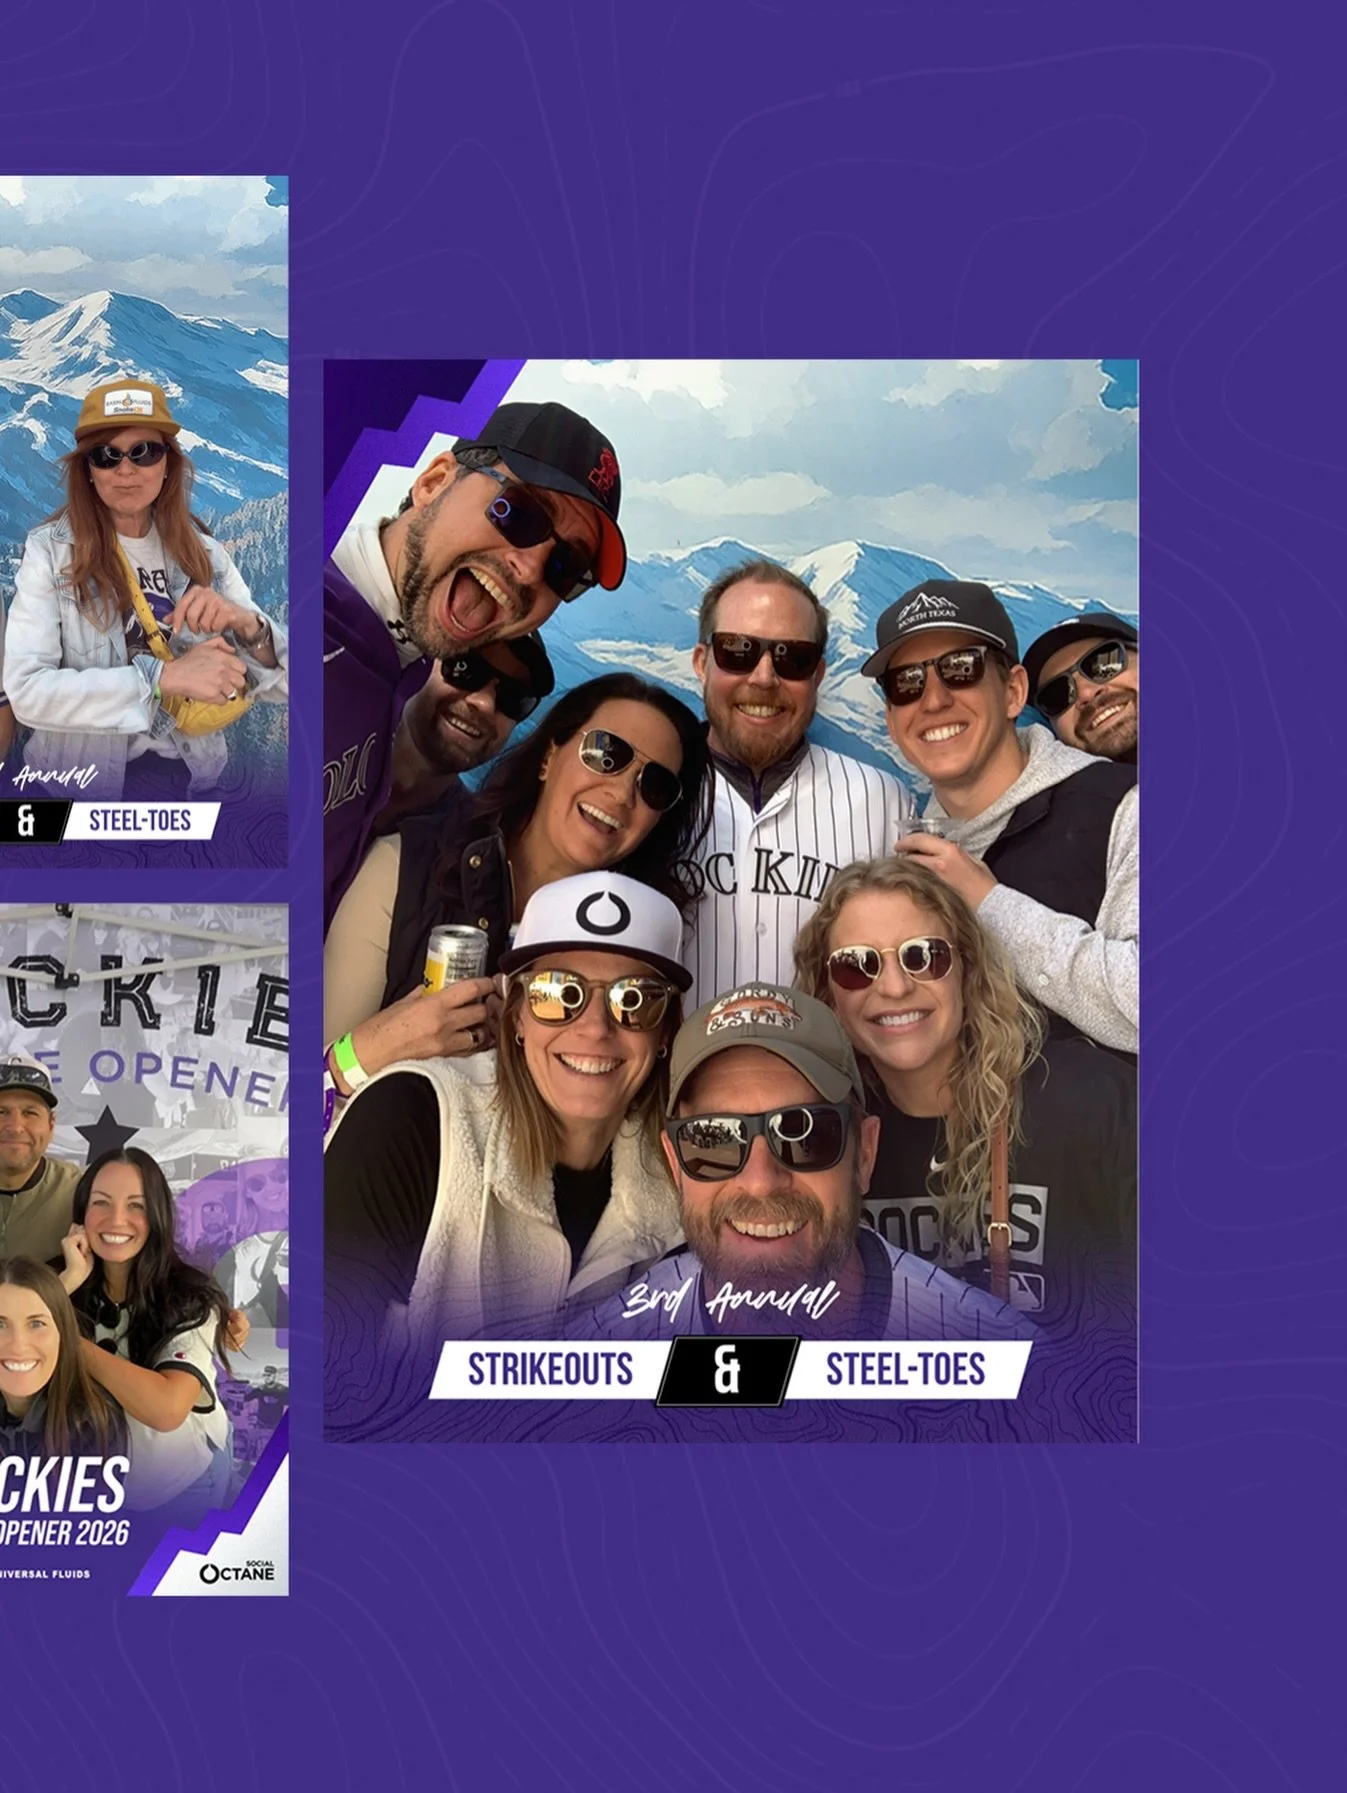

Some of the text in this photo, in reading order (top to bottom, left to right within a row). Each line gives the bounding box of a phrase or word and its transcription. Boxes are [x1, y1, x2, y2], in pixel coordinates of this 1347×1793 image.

[898, 609, 957, 630] NORTH TEXAS
[89, 1049, 289, 1113] OPENE
